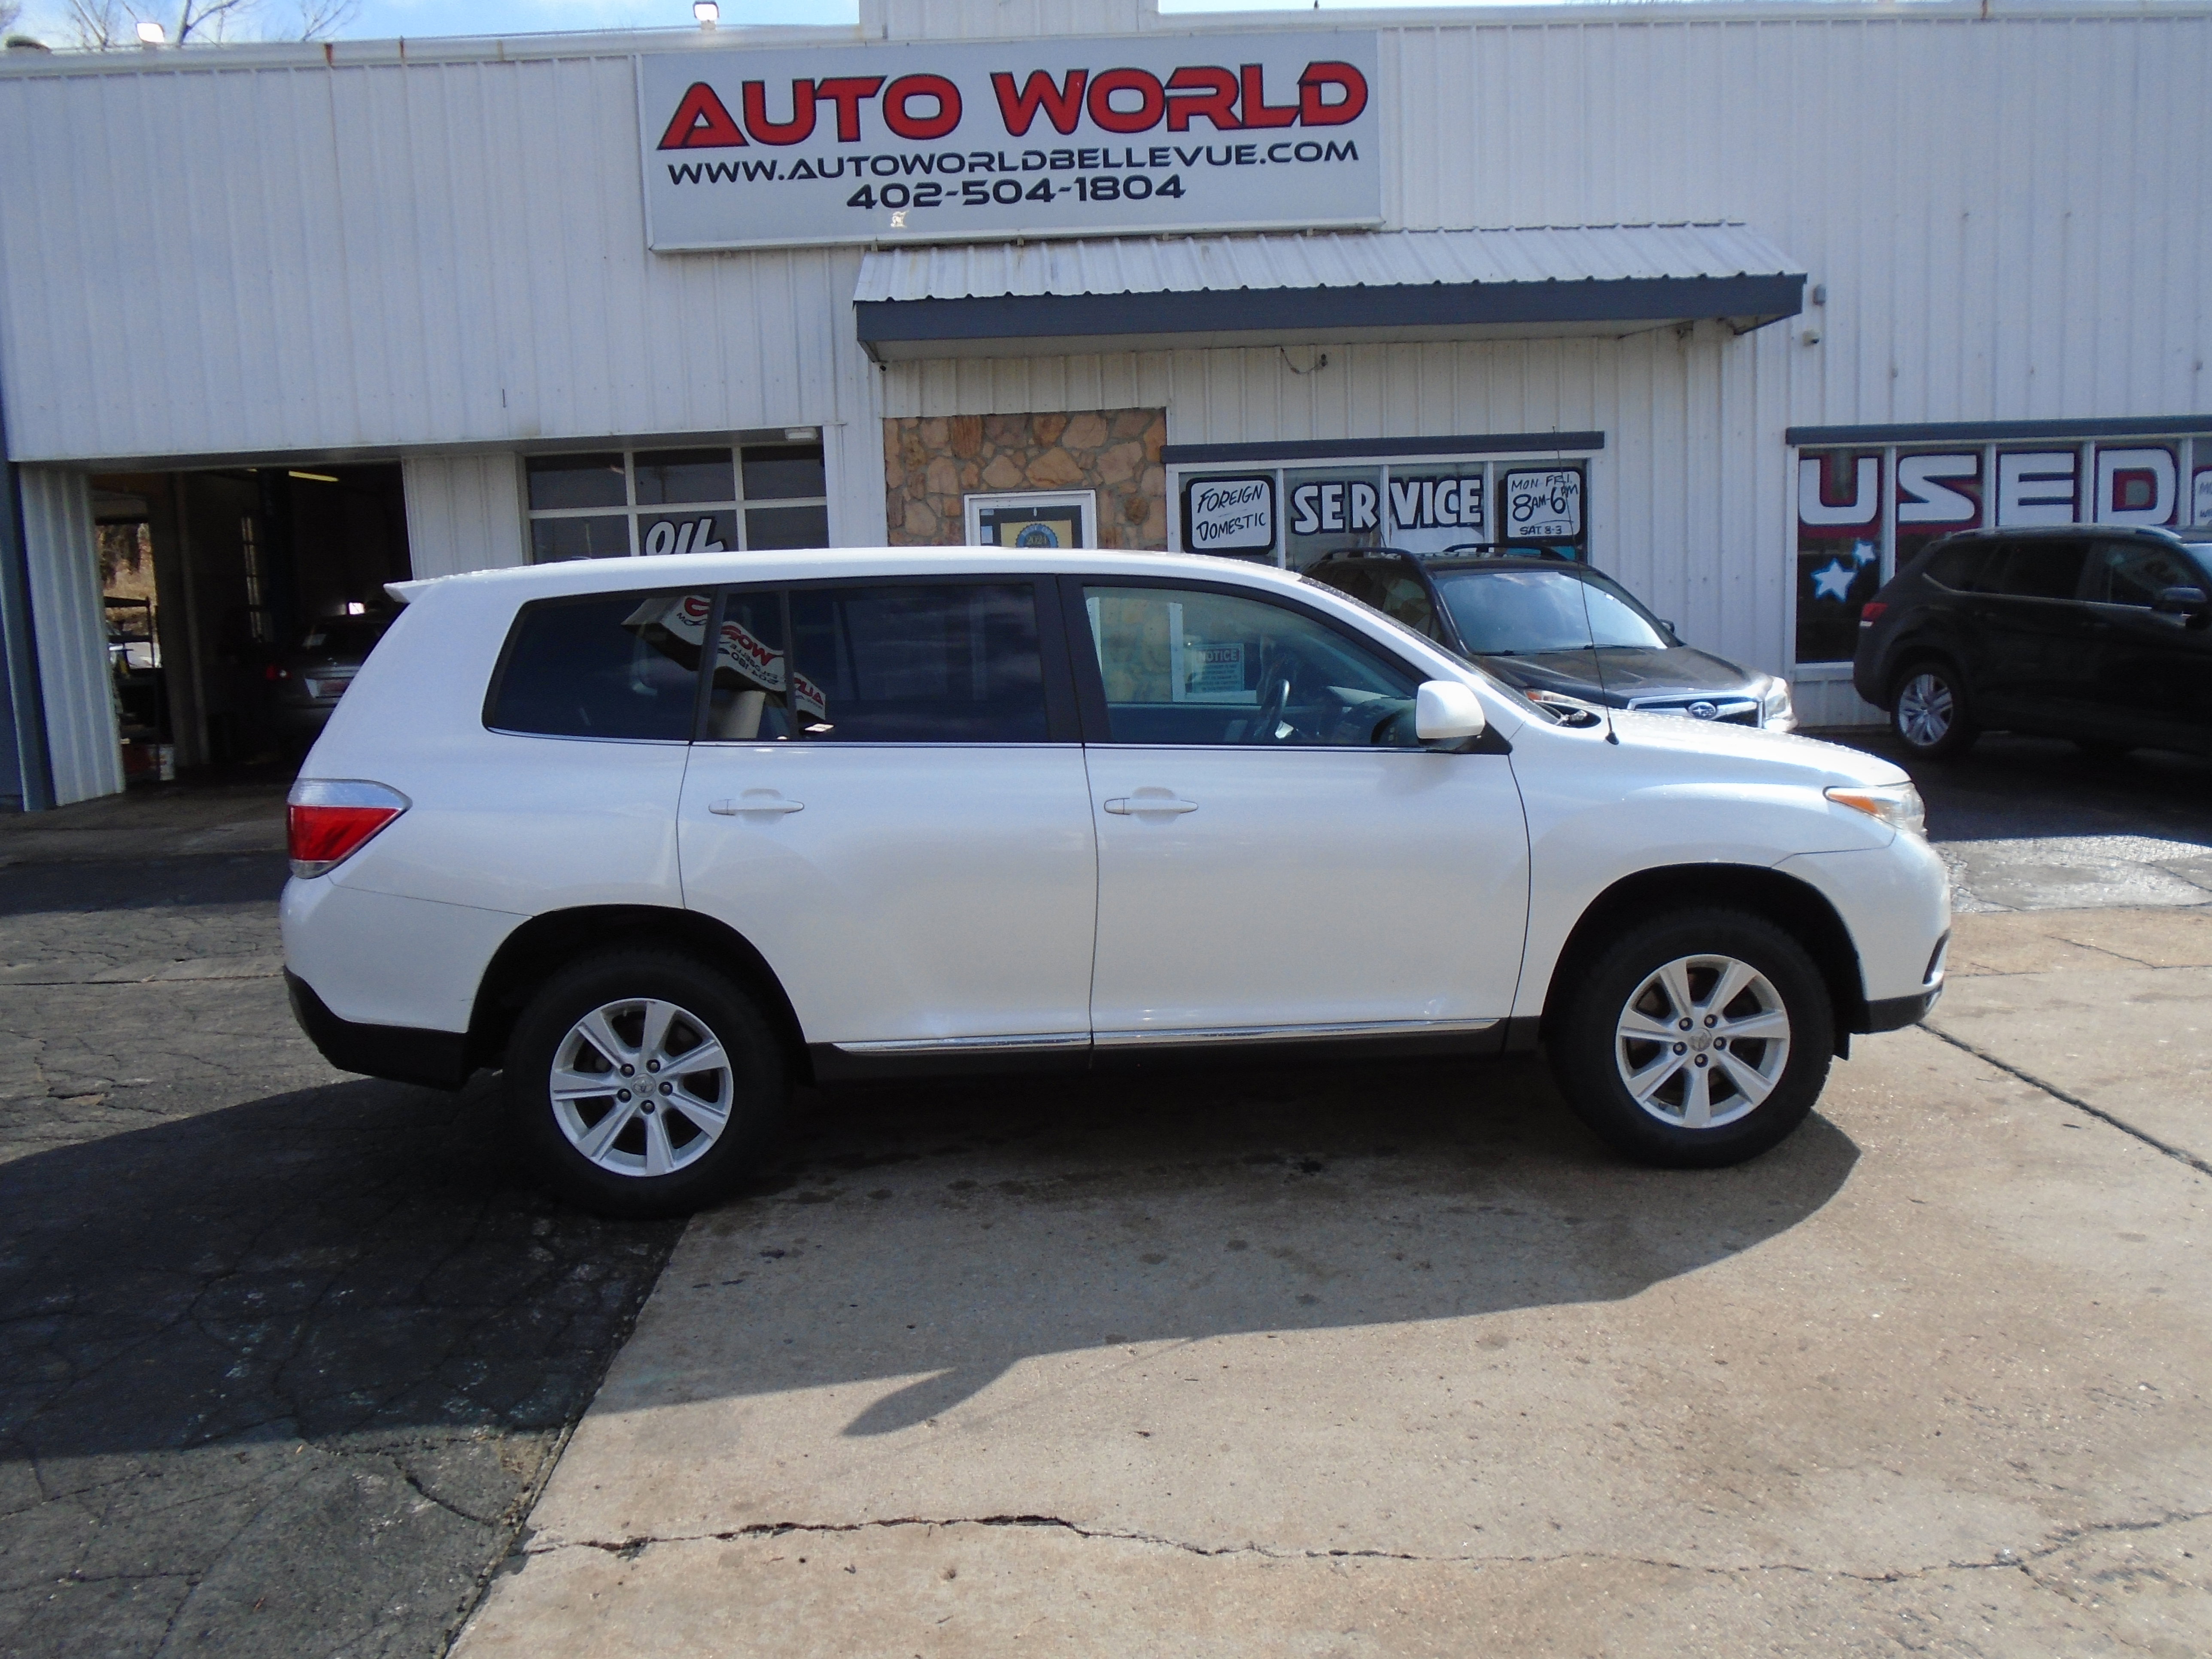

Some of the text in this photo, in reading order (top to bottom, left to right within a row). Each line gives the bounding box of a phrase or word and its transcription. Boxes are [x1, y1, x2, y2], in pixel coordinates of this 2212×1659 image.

[656, 60, 1368, 150] AUTO WORLD
[668, 140, 1359, 185] WWW.AUTOWORLDBELLEVUE.COM
[847, 174, 1186, 210] 402-504-1804
[1197, 483, 1263, 514] FOREIGN
[1511, 478, 1538, 492] MON
[1799, 448, 2178, 526] USED
[1291, 476, 1484, 535] SERVICE
[645, 518, 726, 556] OIL
[1196, 511, 1266, 542] DOMESTIC
[1545, 526, 1562, 534] 8-3
